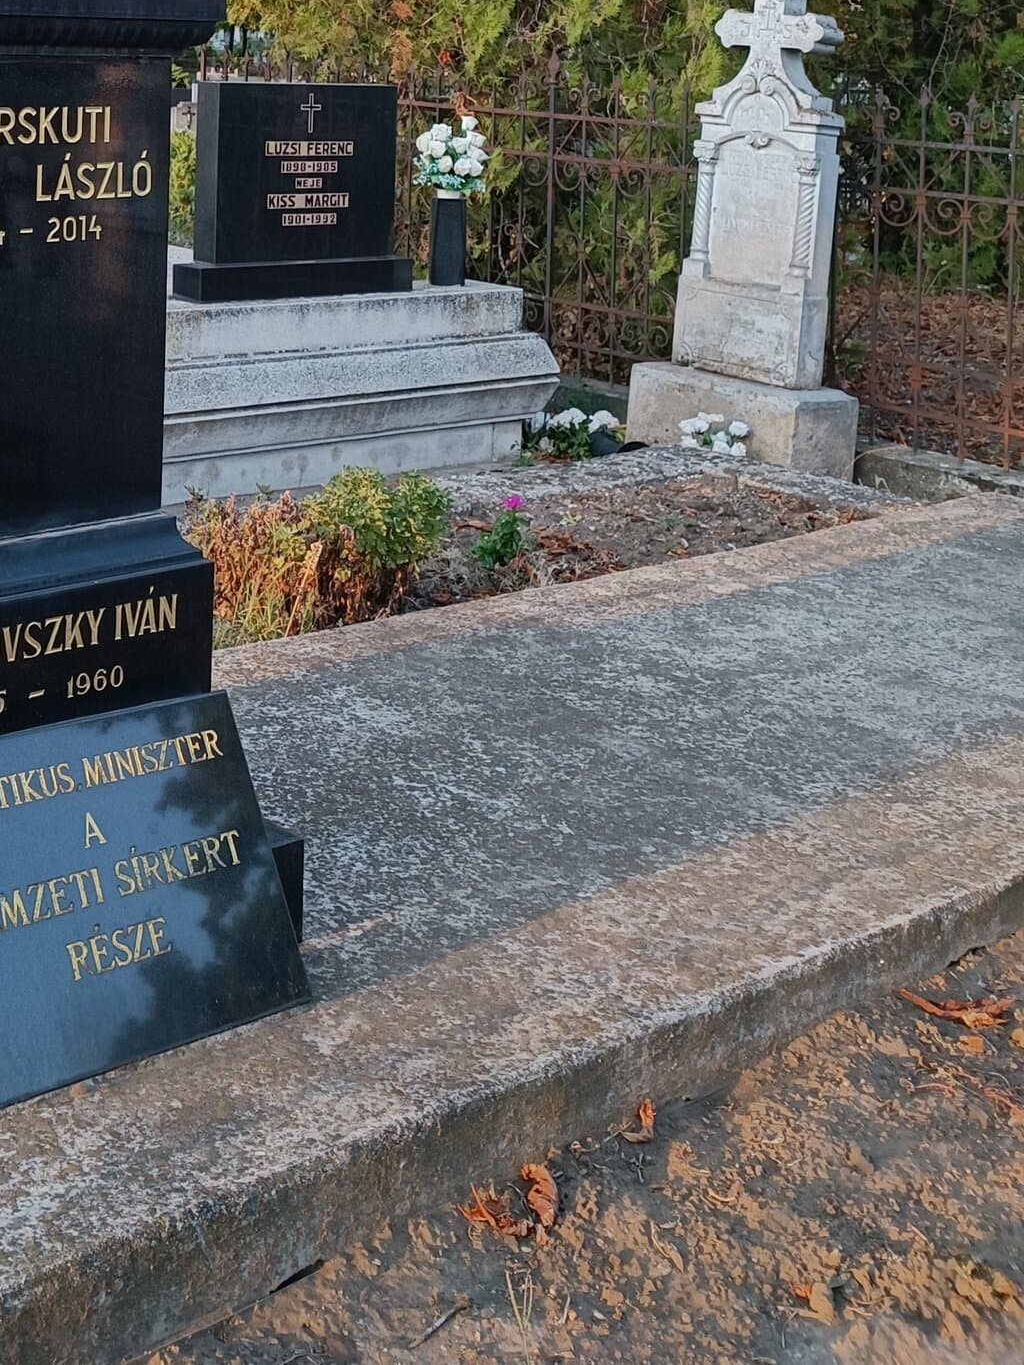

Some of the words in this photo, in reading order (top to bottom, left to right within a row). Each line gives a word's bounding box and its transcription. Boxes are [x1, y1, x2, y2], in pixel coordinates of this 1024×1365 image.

[267, 142, 301, 155] LUZSI
[307, 142, 352, 155] FERENC
[36, 149, 152, 202] LÁSZLÓ
[296, 179, 321, 188] NEJE
[268, 195, 296, 208] KISS
[305, 194, 347, 207] MARGIT
[46, 214, 102, 243] 2014
[114, 585, 178, 642] IVÁN
[66, 665, 124, 699] 1960
[81, 728, 224, 790] MINISZTER
[84, 811, 108, 849] A
[113, 830, 241, 897] SÍRKERT
[65, 917, 173, 981] RÉSZE
